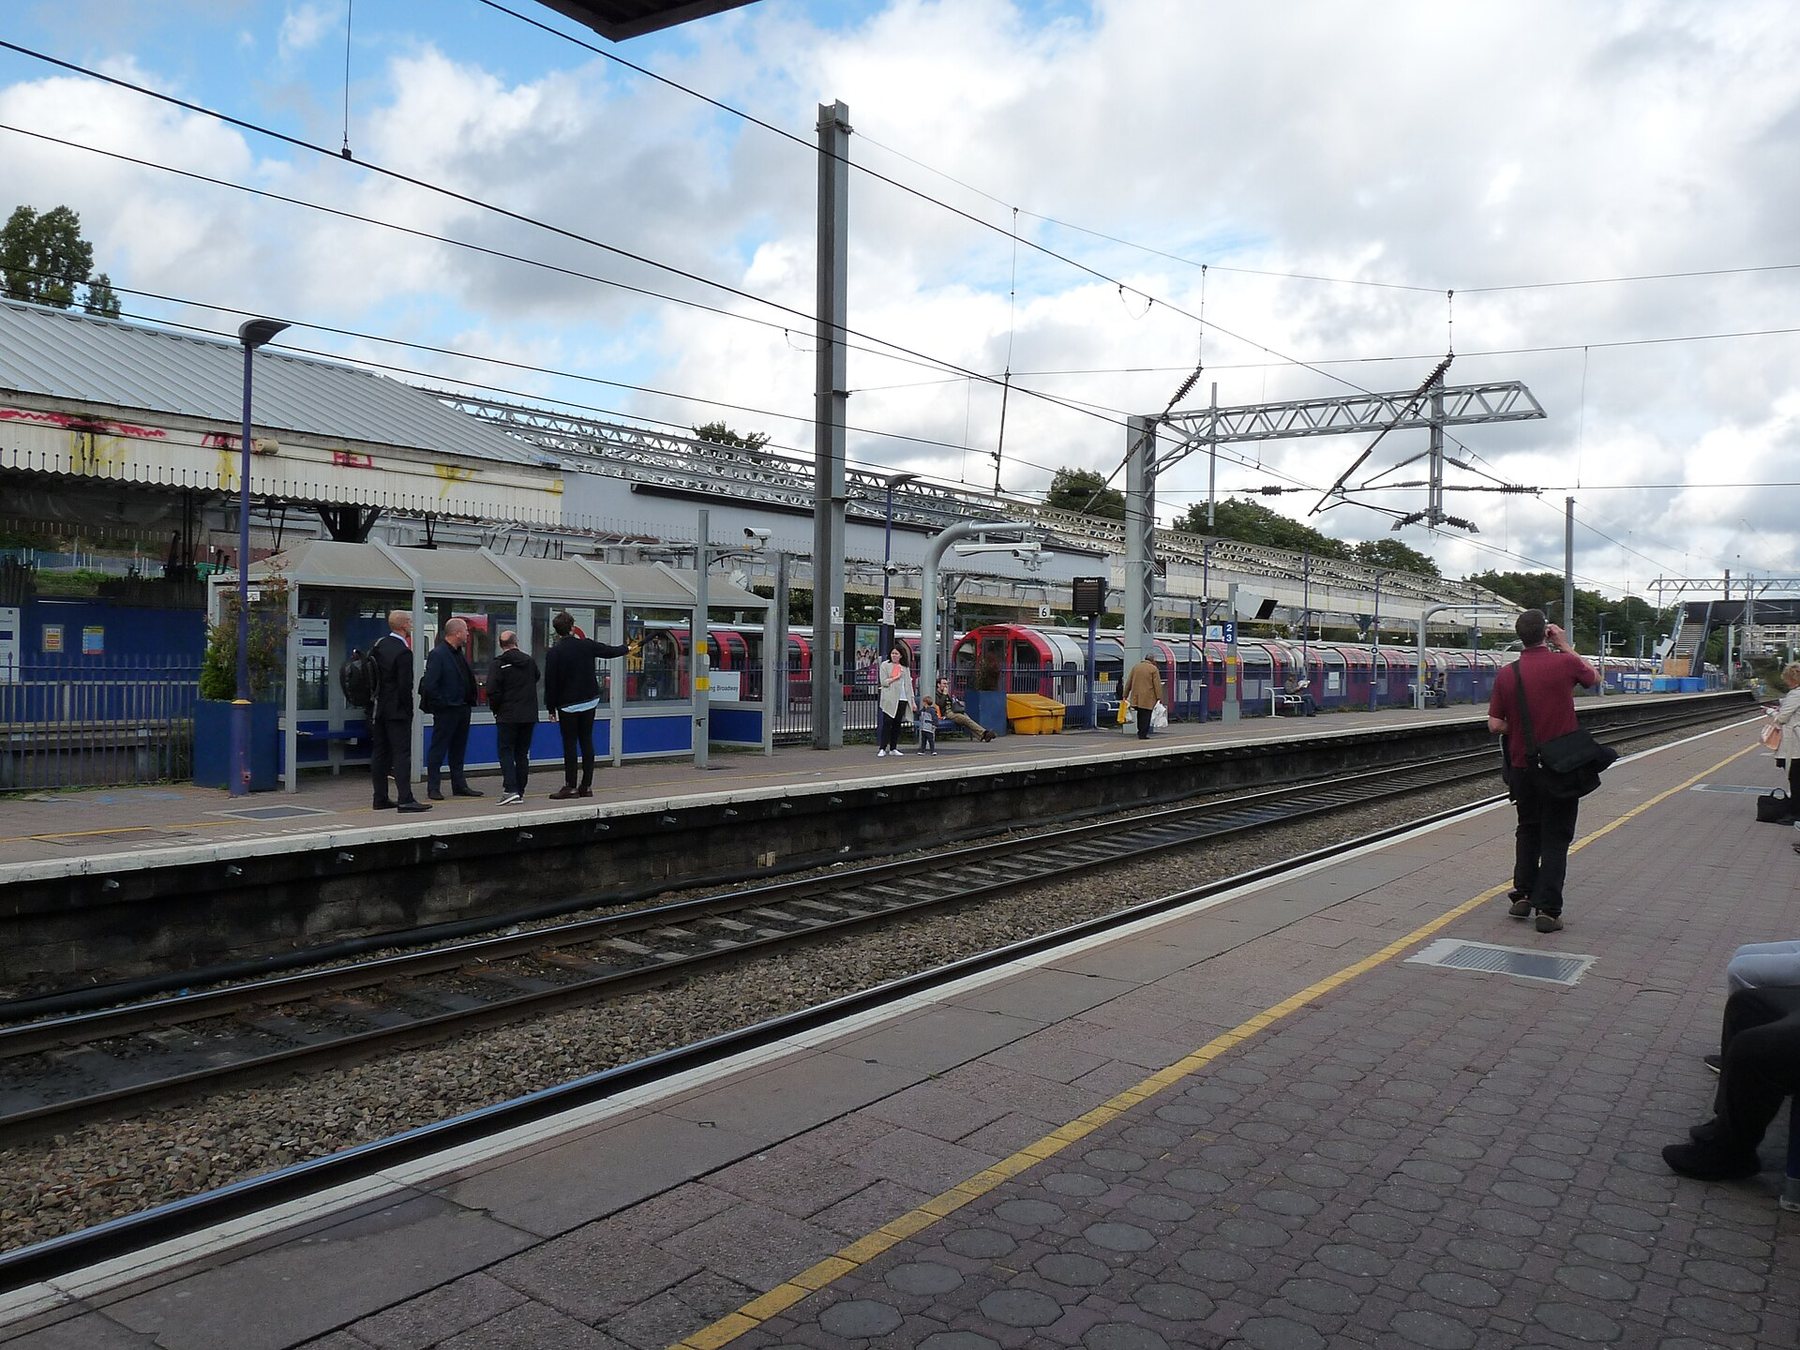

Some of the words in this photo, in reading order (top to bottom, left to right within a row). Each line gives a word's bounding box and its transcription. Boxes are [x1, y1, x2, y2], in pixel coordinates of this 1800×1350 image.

[1041, 607, 1047, 617] 6
[1226, 624, 1233, 632] 2
[1226, 634, 1232, 642] 3
[716, 684, 739, 692] Broadway
